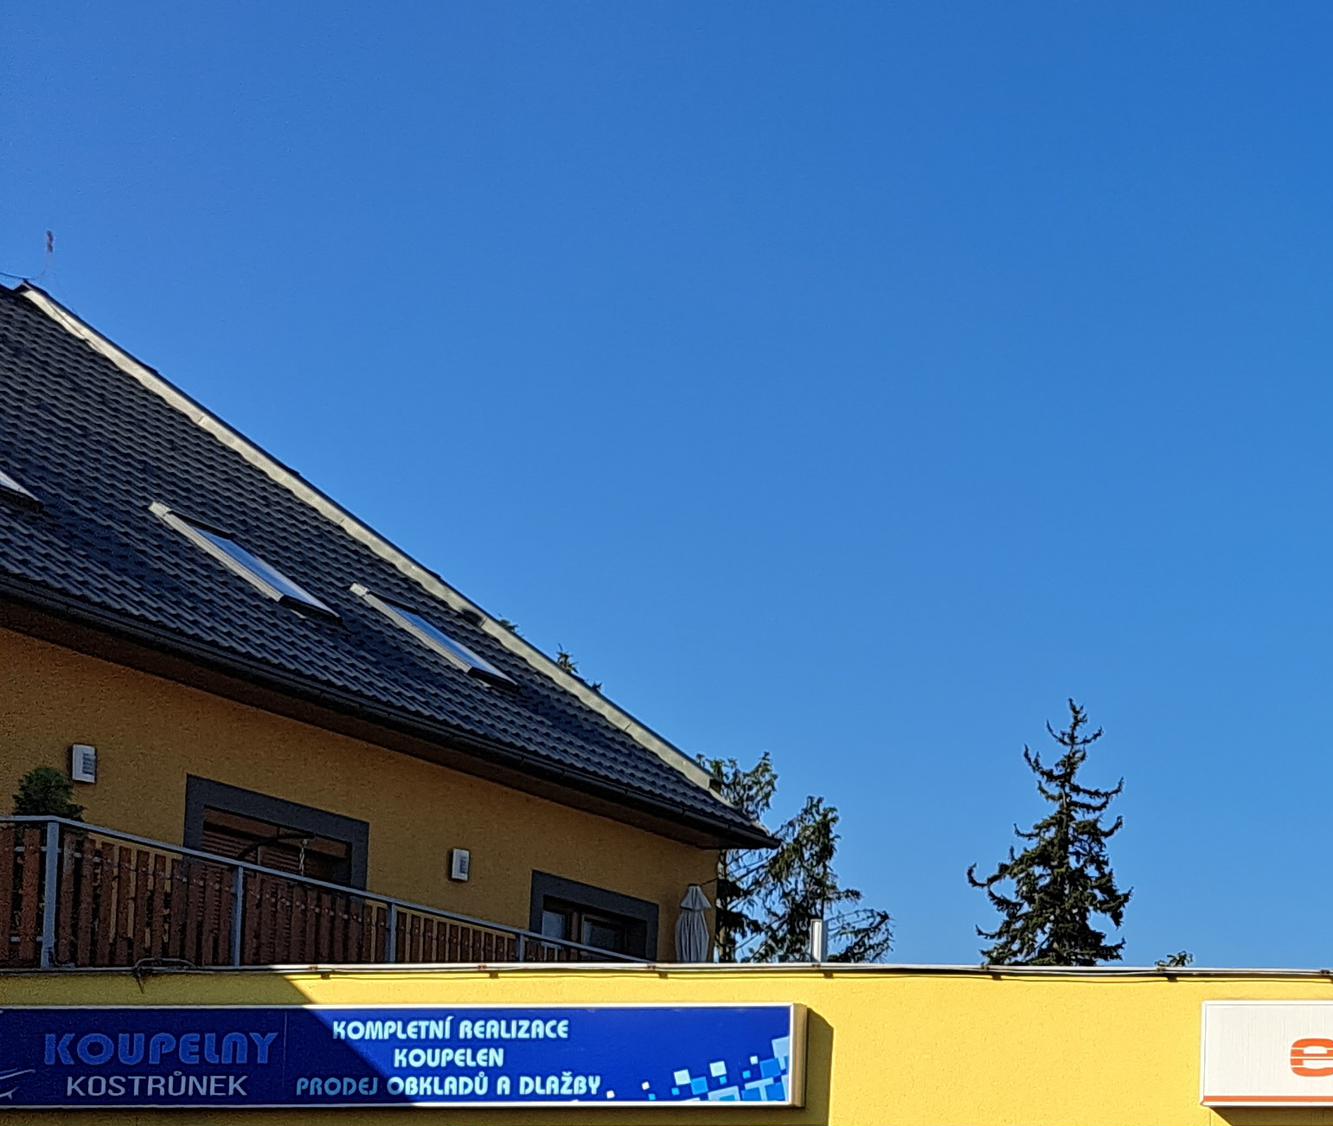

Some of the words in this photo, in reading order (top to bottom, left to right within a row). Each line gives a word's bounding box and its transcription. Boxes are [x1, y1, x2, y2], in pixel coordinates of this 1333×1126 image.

[333, 1016, 455, 1040] KOMPLETNÍ
[459, 1020, 569, 1039] REALIZACE
[44, 1032, 278, 1065] KOUPELNY
[394, 1048, 504, 1068] KOUPELEN
[66, 1071, 249, 1096] KOSTRŮNEK
[296, 1077, 379, 1096] PRODEJ
[387, 1071, 488, 1096] OBKLADŮ
[496, 1076, 511, 1096] A
[519, 1072, 600, 1096] DLAŽBY
